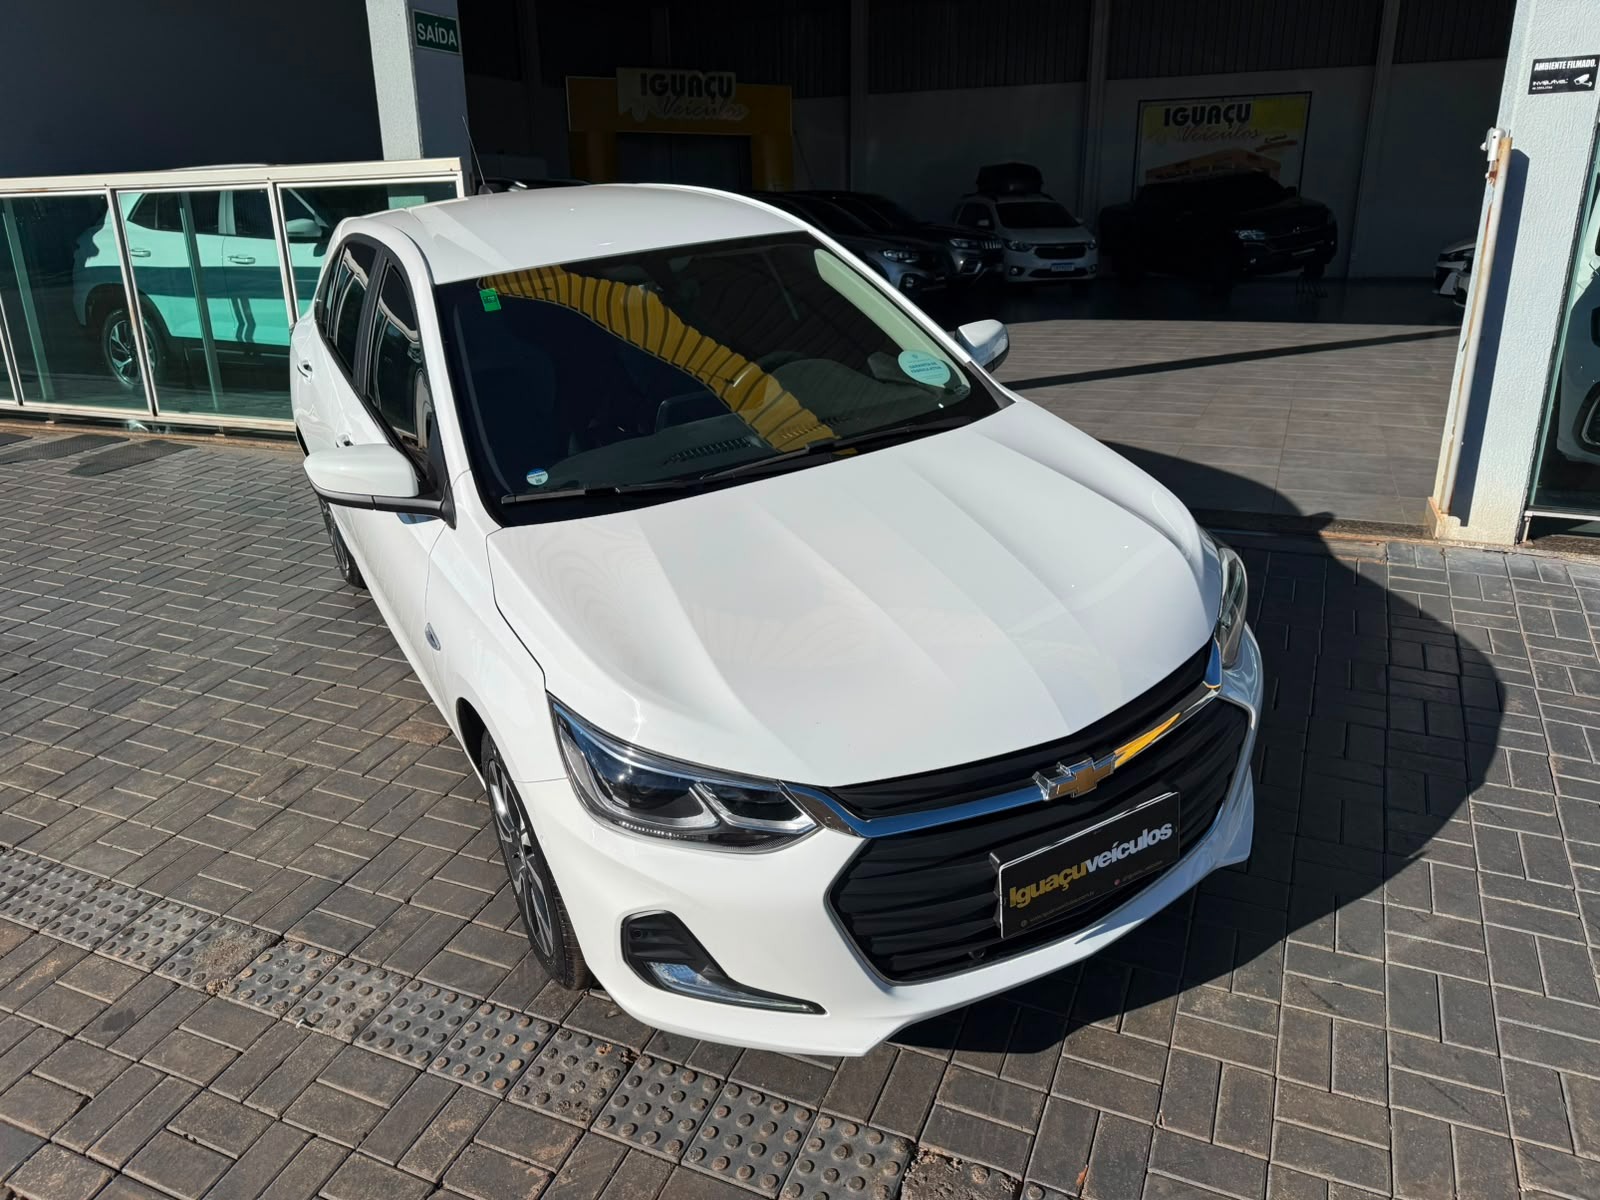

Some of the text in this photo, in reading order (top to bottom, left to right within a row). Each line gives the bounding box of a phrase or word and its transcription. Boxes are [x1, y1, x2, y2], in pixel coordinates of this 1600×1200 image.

[416, 21, 458, 47] SAÍDA
[1534, 61, 1567, 71] AMBIENTE
[640, 71, 734, 104] IGUAÇU
[1164, 103, 1251, 128] IGUAÇU
